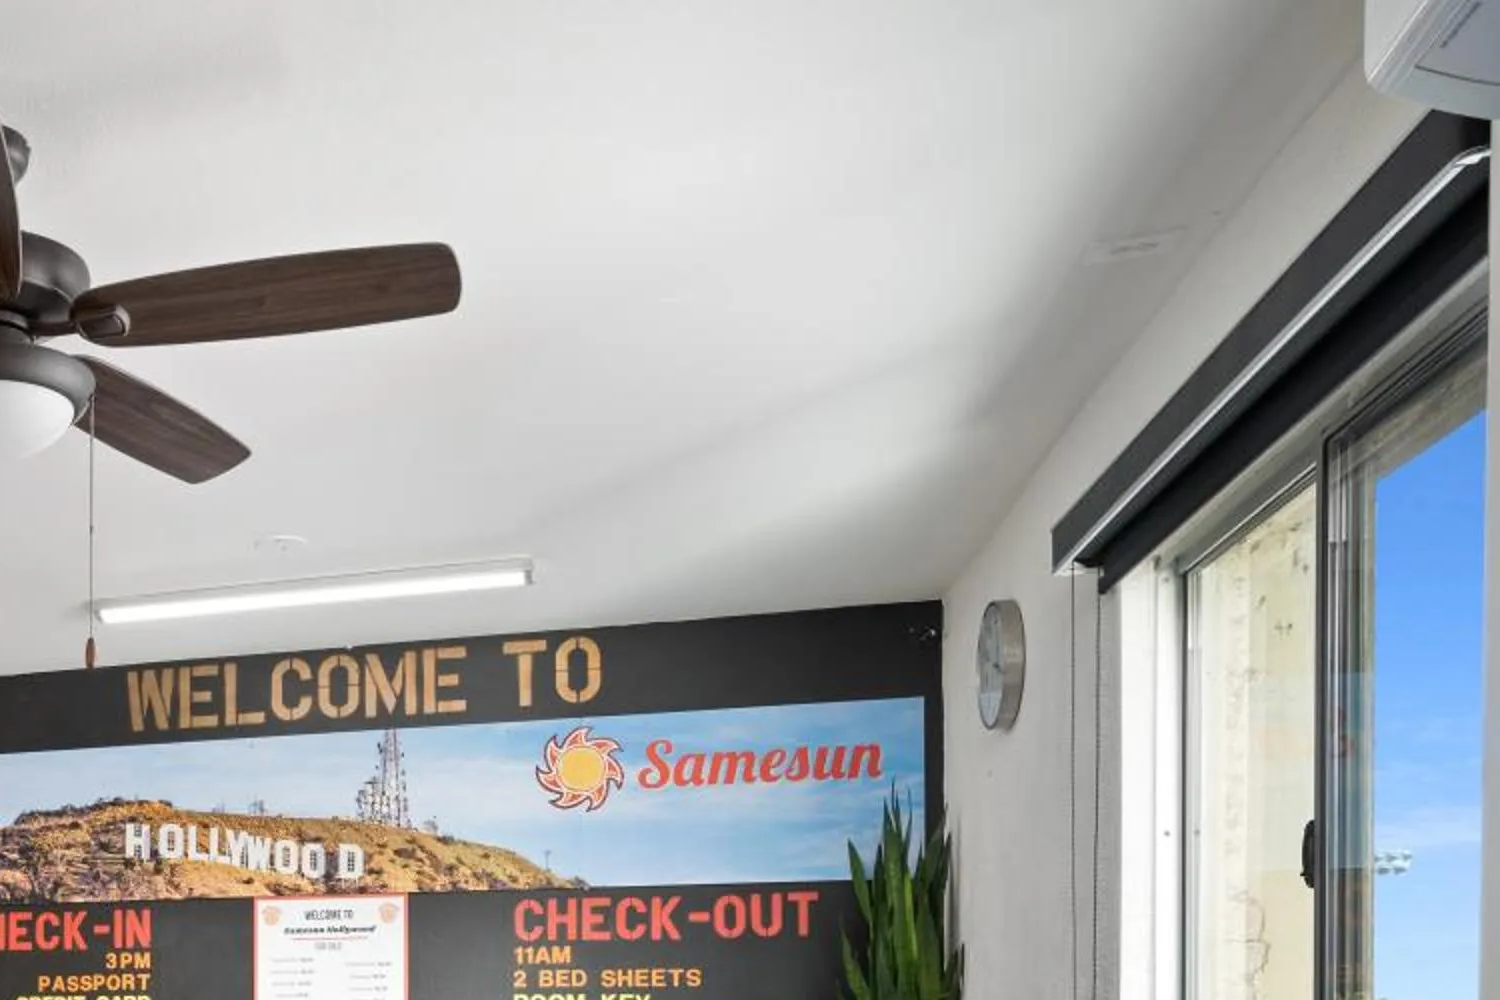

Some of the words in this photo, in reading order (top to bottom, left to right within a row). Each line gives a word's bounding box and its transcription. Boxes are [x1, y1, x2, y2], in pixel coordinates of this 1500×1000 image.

[127, 646, 468, 733] WELCOME
[503, 636, 602, 708] TO
[638, 739, 883, 789] Samesun
[125, 823, 365, 880] HOLLYWOOD
[304, 909, 341, 921] WELCOME
[513, 891, 818, 941] CHECK-OUT
[106, 953, 151, 969] 3PM
[513, 945, 572, 965] 11AM
[38, 973, 151, 992] PASSPORT
[513, 970, 527, 988] 2
[539, 969, 588, 988] BED
[601, 968, 702, 988] SHEETS
